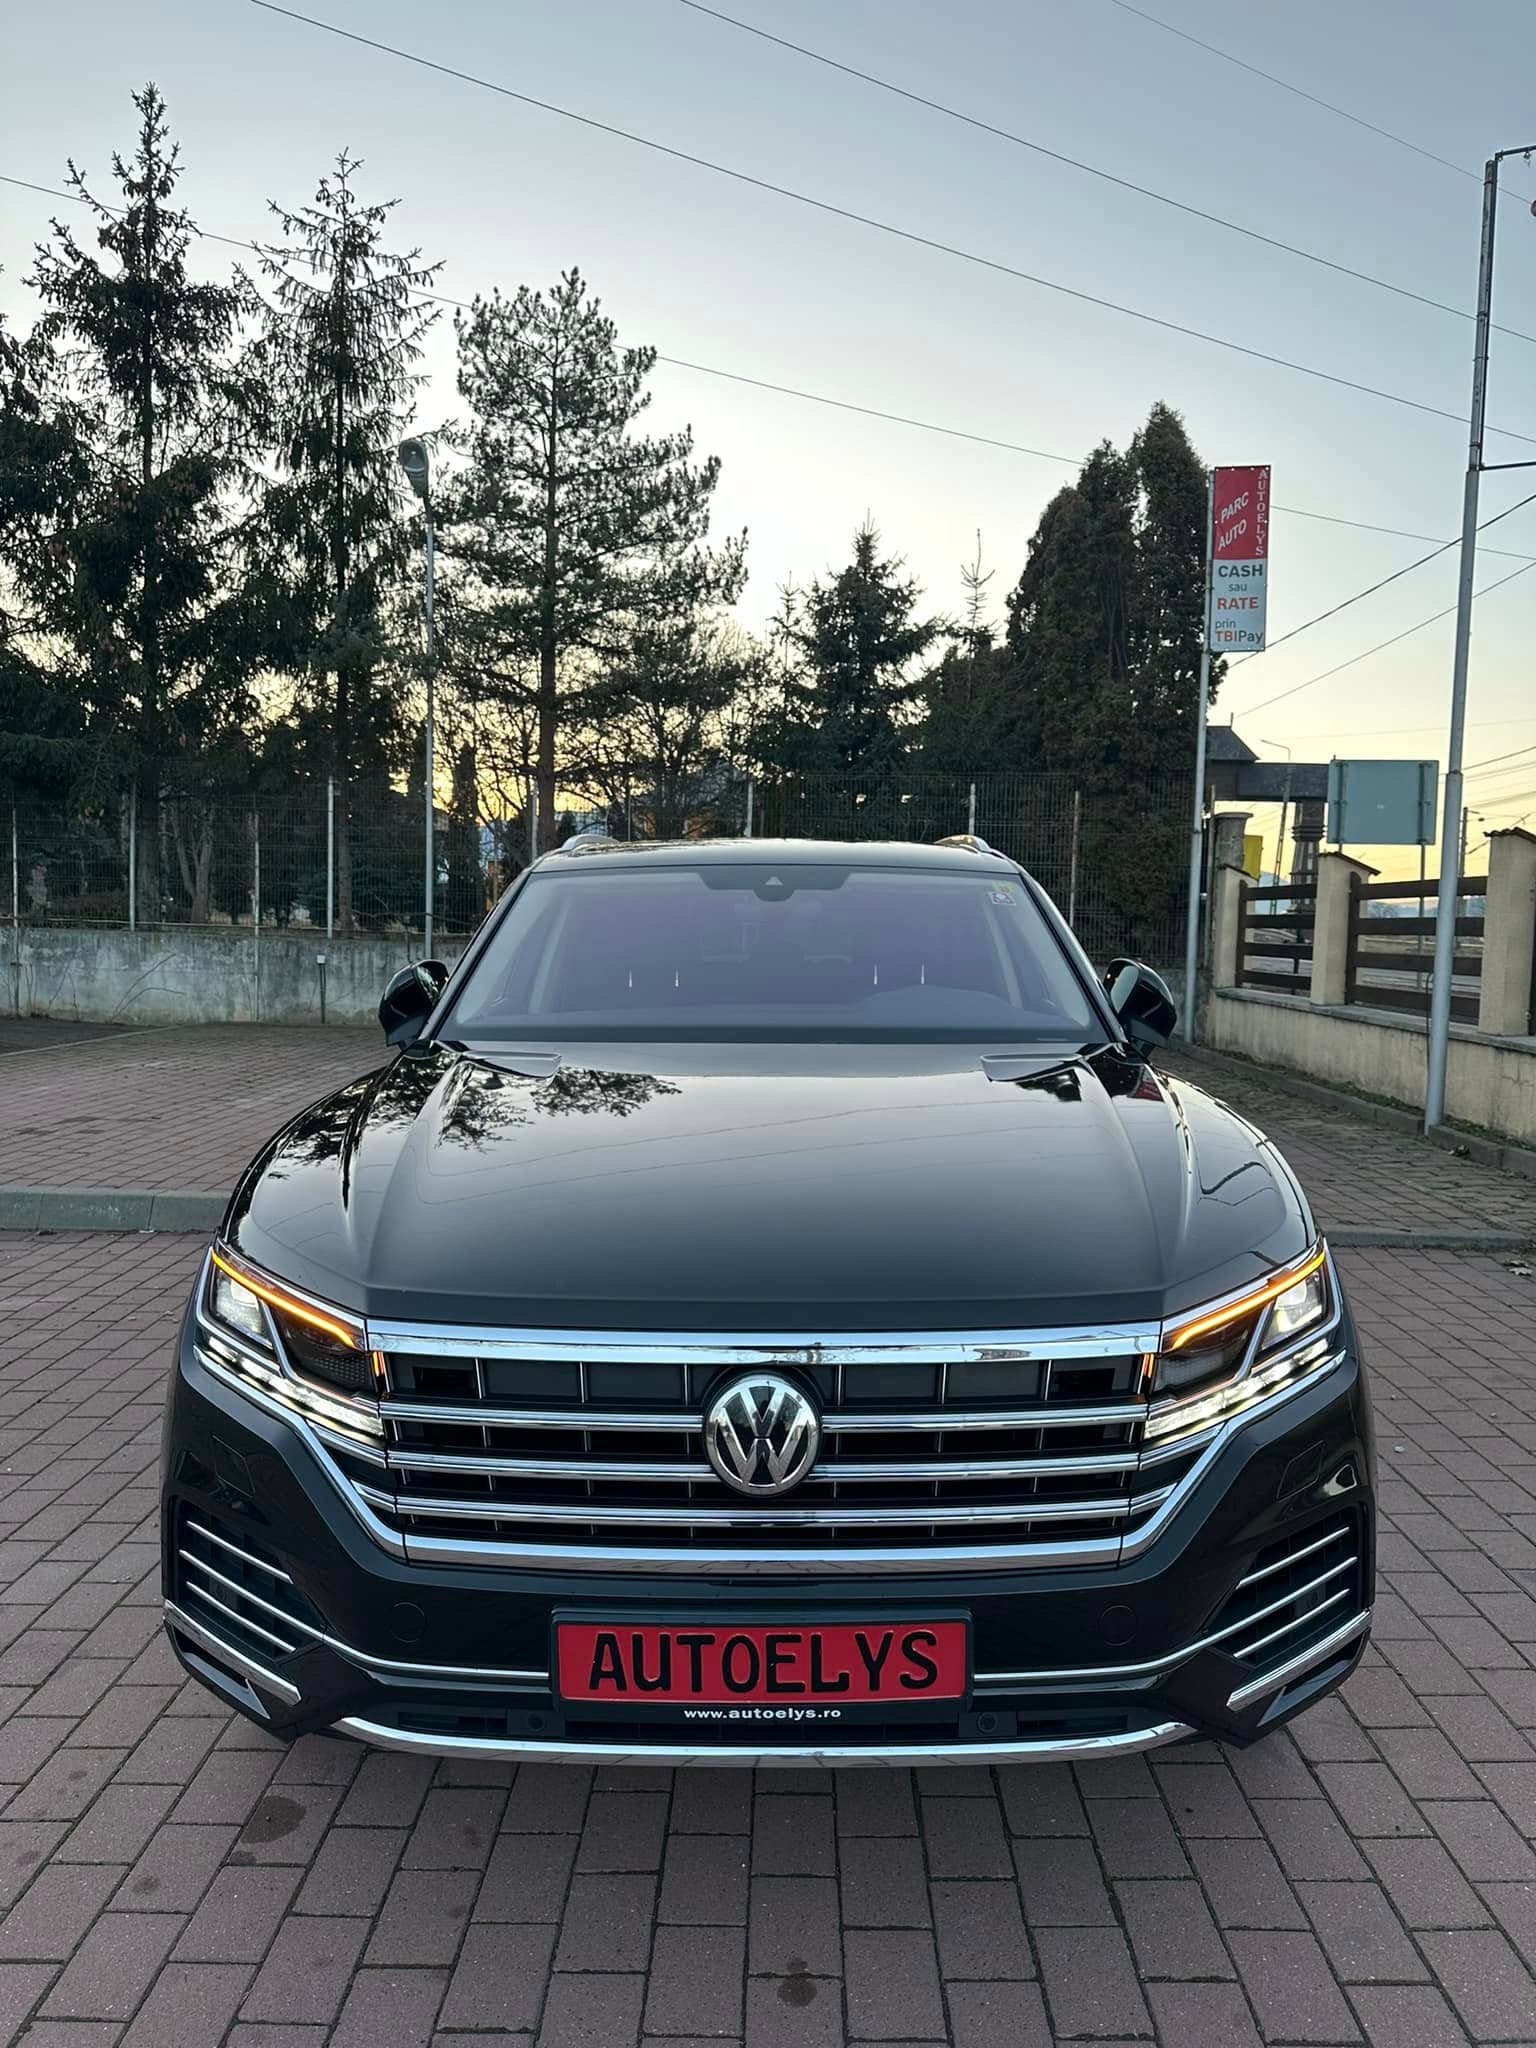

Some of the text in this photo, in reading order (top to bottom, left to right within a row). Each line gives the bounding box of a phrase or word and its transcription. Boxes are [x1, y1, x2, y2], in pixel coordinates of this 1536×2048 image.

[1220, 492, 1249, 524] PARC
[1255, 469, 1269, 556] AUTOELYS
[1218, 519, 1247, 551] AUTO
[1218, 564, 1263, 578] CASH
[1228, 582, 1247, 592] sau
[1217, 597, 1259, 610] RATE
[1215, 618, 1236, 631] prin
[1215, 630, 1264, 645] TBIPay
[708, 1377, 817, 1494] VW
[588, 1631, 939, 1694] AUTOELYS
[684, 1707, 842, 1721] www.autoelys.ro
